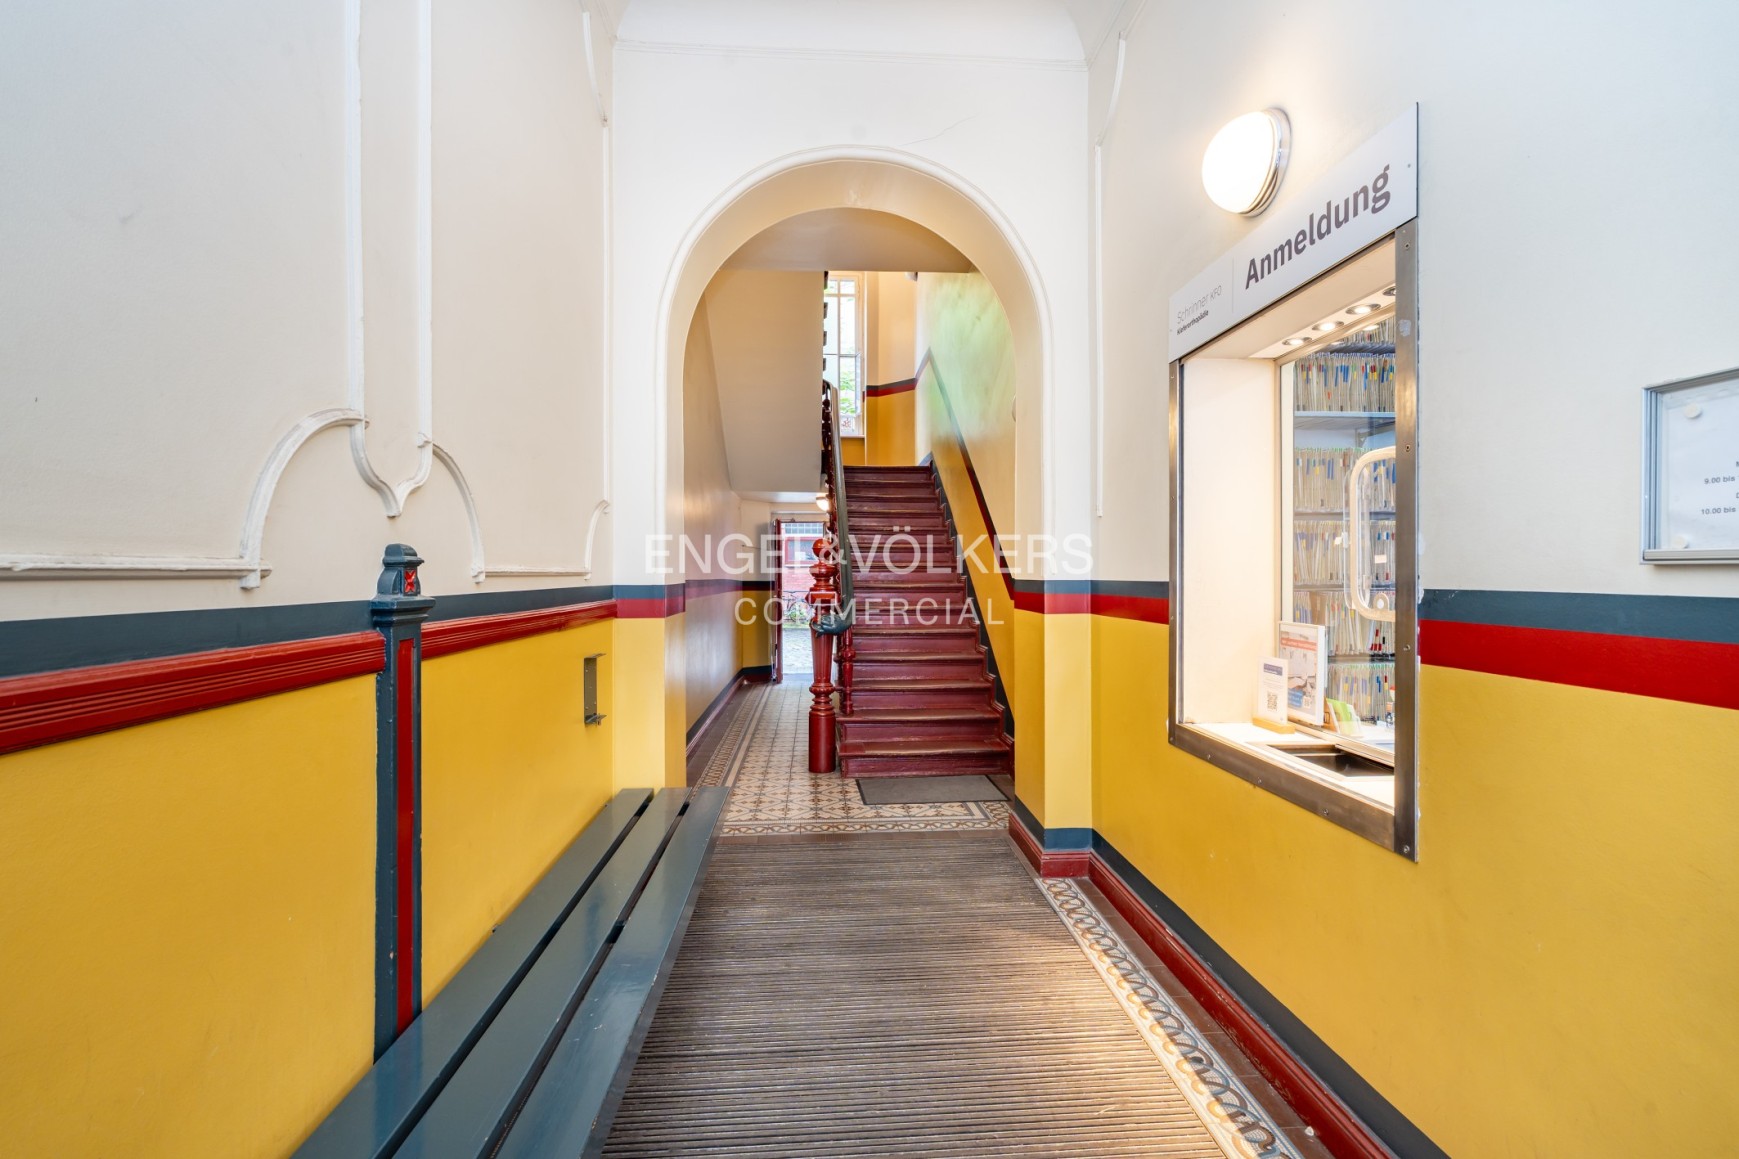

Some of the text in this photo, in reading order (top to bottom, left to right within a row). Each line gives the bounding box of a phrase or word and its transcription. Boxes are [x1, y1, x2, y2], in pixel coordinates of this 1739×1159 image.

[1246, 164, 1391, 290] Anmeldung
[1704, 475, 1736, 485] 9.00 bis
[1701, 506, 1736, 515] 10.00 bis
